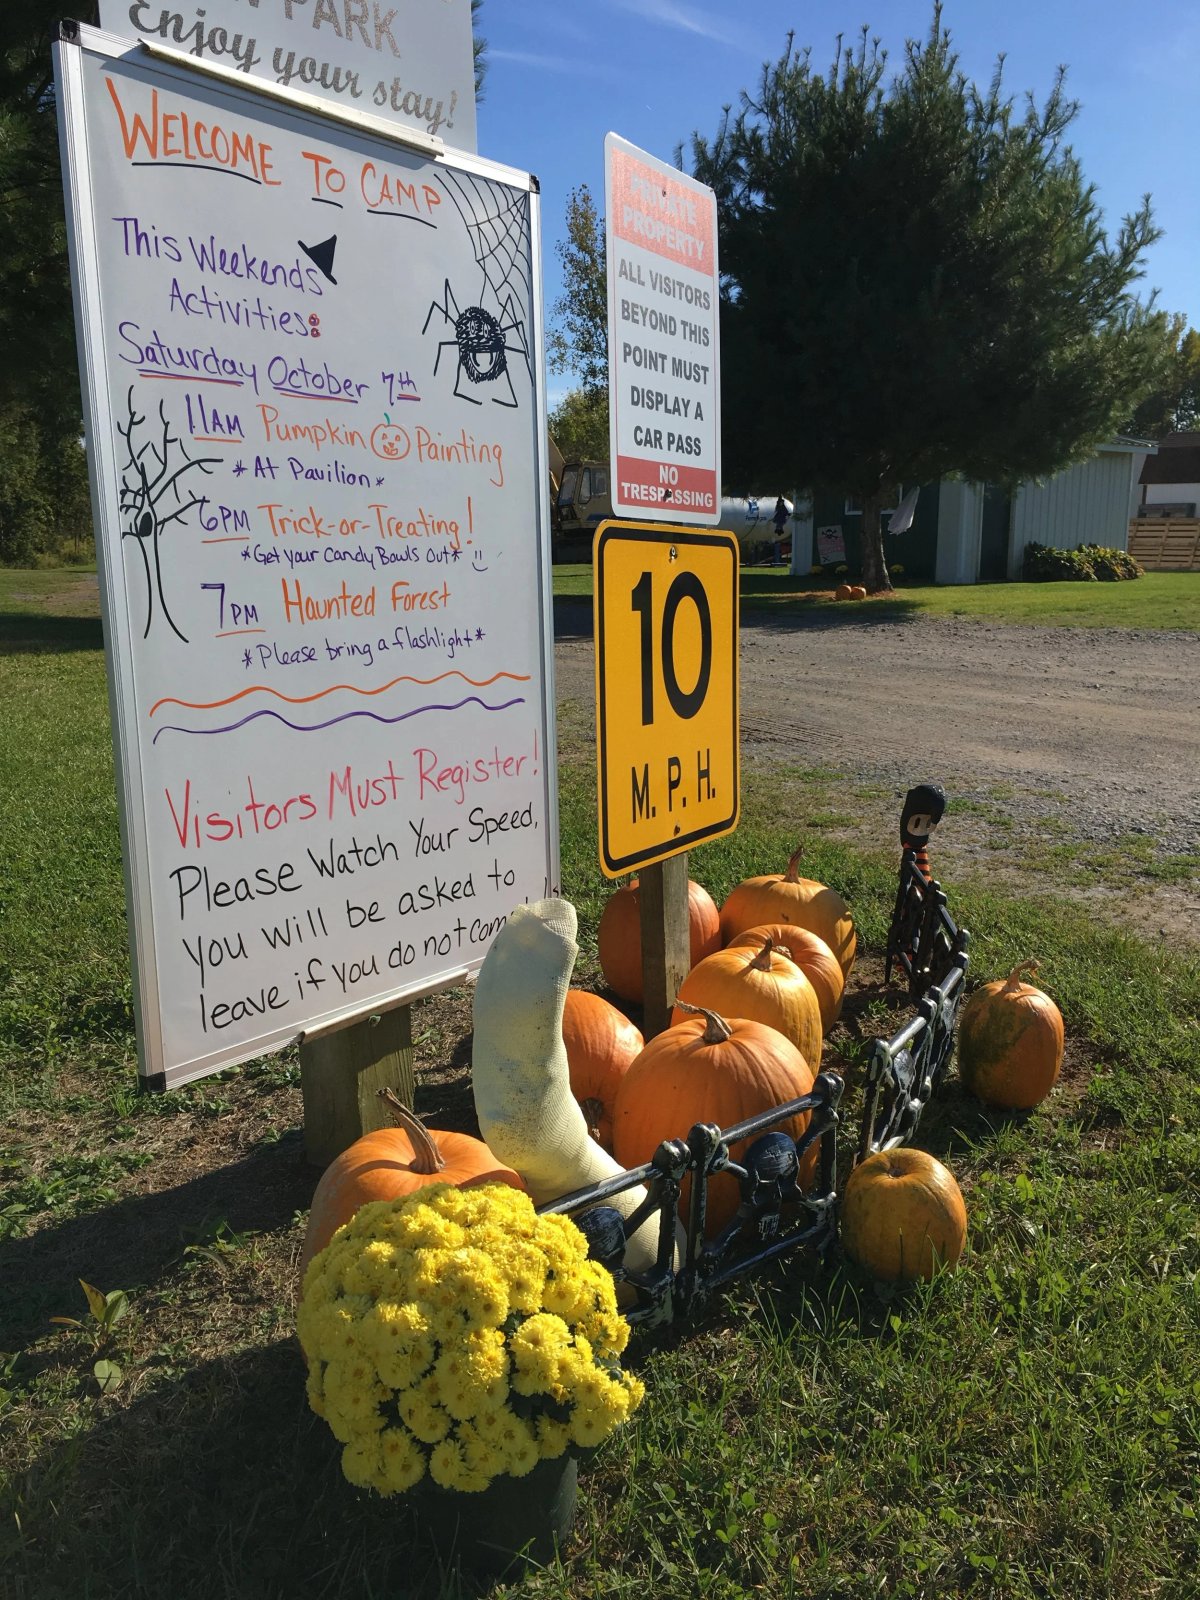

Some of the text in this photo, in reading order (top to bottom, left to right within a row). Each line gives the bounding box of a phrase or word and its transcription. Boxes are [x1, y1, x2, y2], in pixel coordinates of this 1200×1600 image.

[128, 0, 458, 135] Enjoy your stay!
[105, 77, 441, 214] WELCOME TO CAMP
[629, 170, 697, 226] PRIVATE
[112, 217, 323, 295] This Weekends
[623, 205, 705, 260] PROPERTY
[619, 258, 710, 310] ALL VISITORS
[621, 298, 710, 347] BEYOND THIS
[119, 321, 417, 405] Saturday October 7th
[623, 342, 709, 386] POINT MUST
[630, 384, 704, 421] DISPLAY A
[256, 404, 367, 450] Pumpkin
[416, 424, 504, 487] Painting
[633, 424, 702, 457] CAR PASS
[621, 482, 713, 508] TRESPASSING
[659, 465, 679, 486] NO
[199, 497, 251, 532] 6PM
[283, 549, 319, 573] your
[377, 545, 420, 564] Bowls
[281, 577, 376, 625] Haunted
[391, 579, 451, 612] Forest
[325, 637, 378, 667] bring
[378, 638, 389, 651] a
[631, 571, 712, 726] 10
[166, 729, 538, 848] Visitors Must Register!
[169, 863, 303, 921] Please
[307, 834, 399, 878] Watch
[409, 818, 460, 858] Your
[346, 899, 386, 929] be
[398, 873, 476, 917] asked
[487, 857, 516, 892] to
[200, 984, 290, 1034] leave
[294, 958, 327, 1000] if
[332, 954, 380, 994] you
[388, 941, 416, 970] do
[423, 918, 467, 957] not
